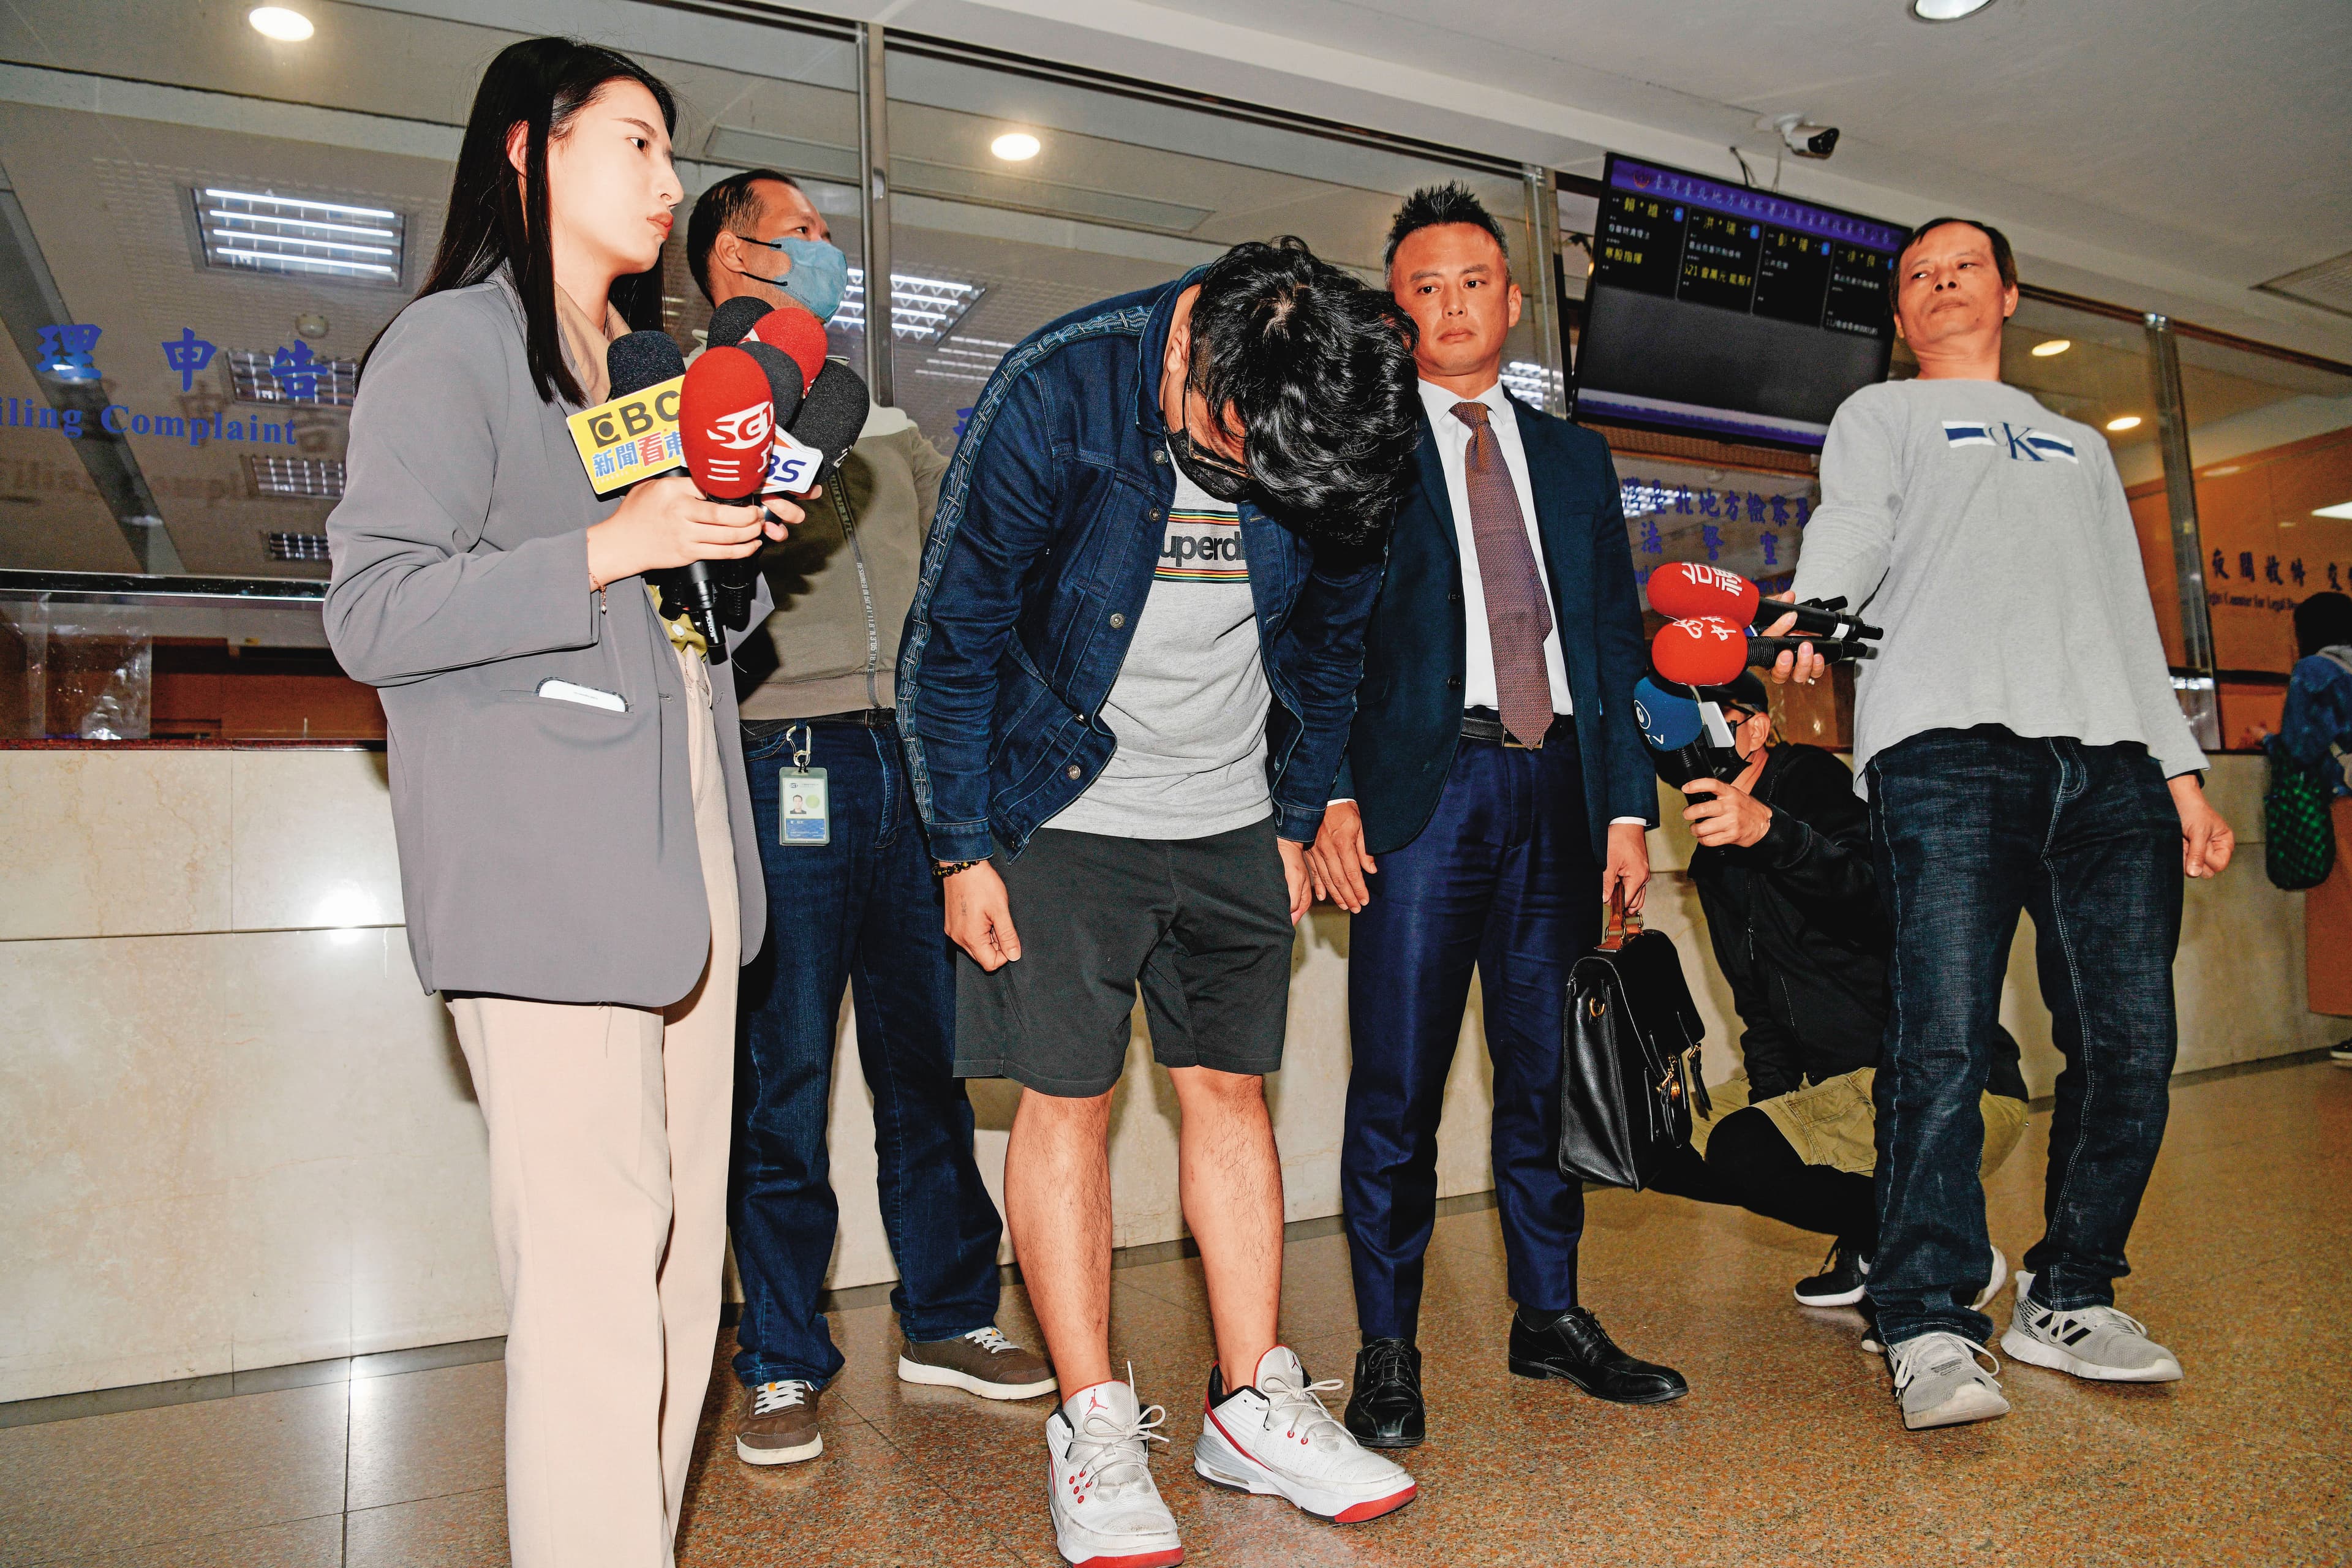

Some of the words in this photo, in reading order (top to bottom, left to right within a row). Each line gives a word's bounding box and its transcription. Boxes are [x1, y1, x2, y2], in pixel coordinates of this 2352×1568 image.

[101, 405, 297, 447] Complaint
[1160, 532, 1245, 567] uperd
[857, 562, 868, 589] DESIGNED
